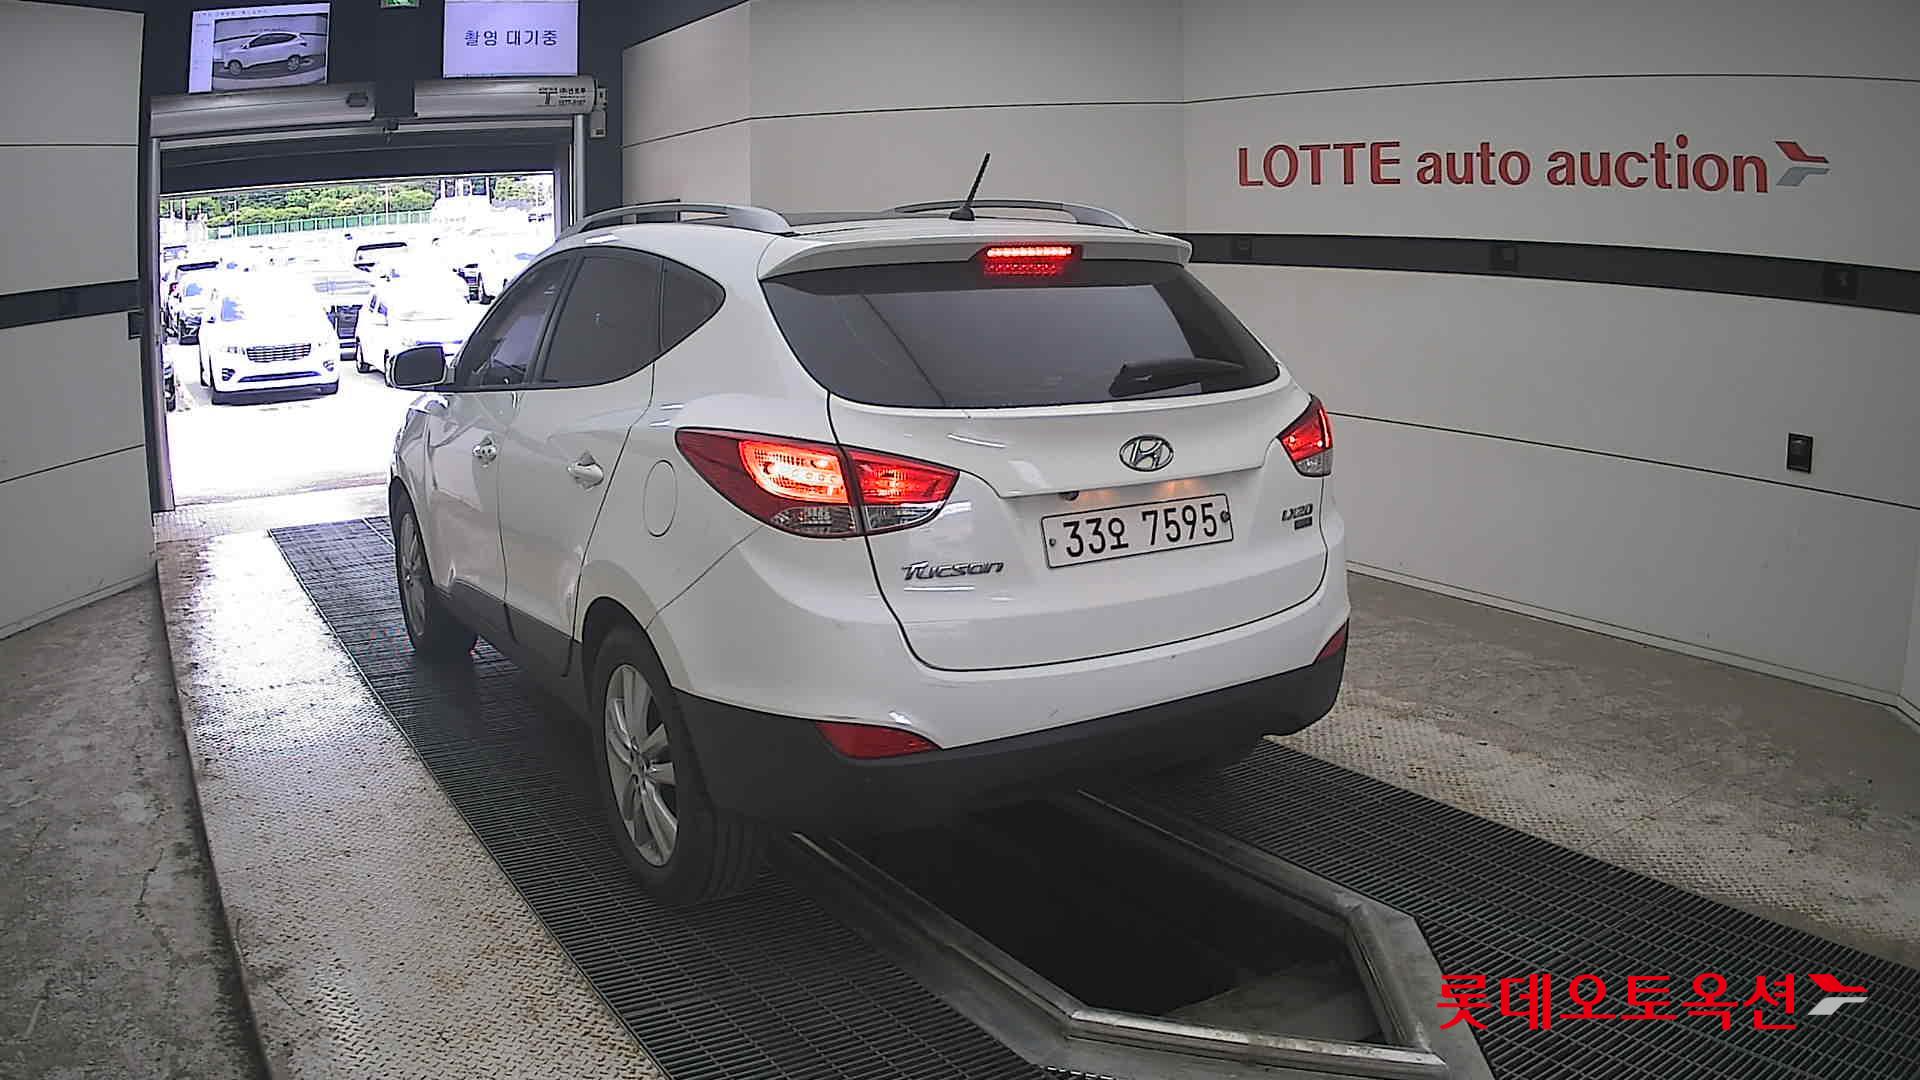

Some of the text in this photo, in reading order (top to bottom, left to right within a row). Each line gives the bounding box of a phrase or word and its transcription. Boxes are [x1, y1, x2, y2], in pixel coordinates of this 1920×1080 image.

[464, 29, 558, 47] 촬영 대기중
[1238, 134, 1768, 193] LOTTE auto auction
[1063, 502, 1218, 557] 33오 7595
